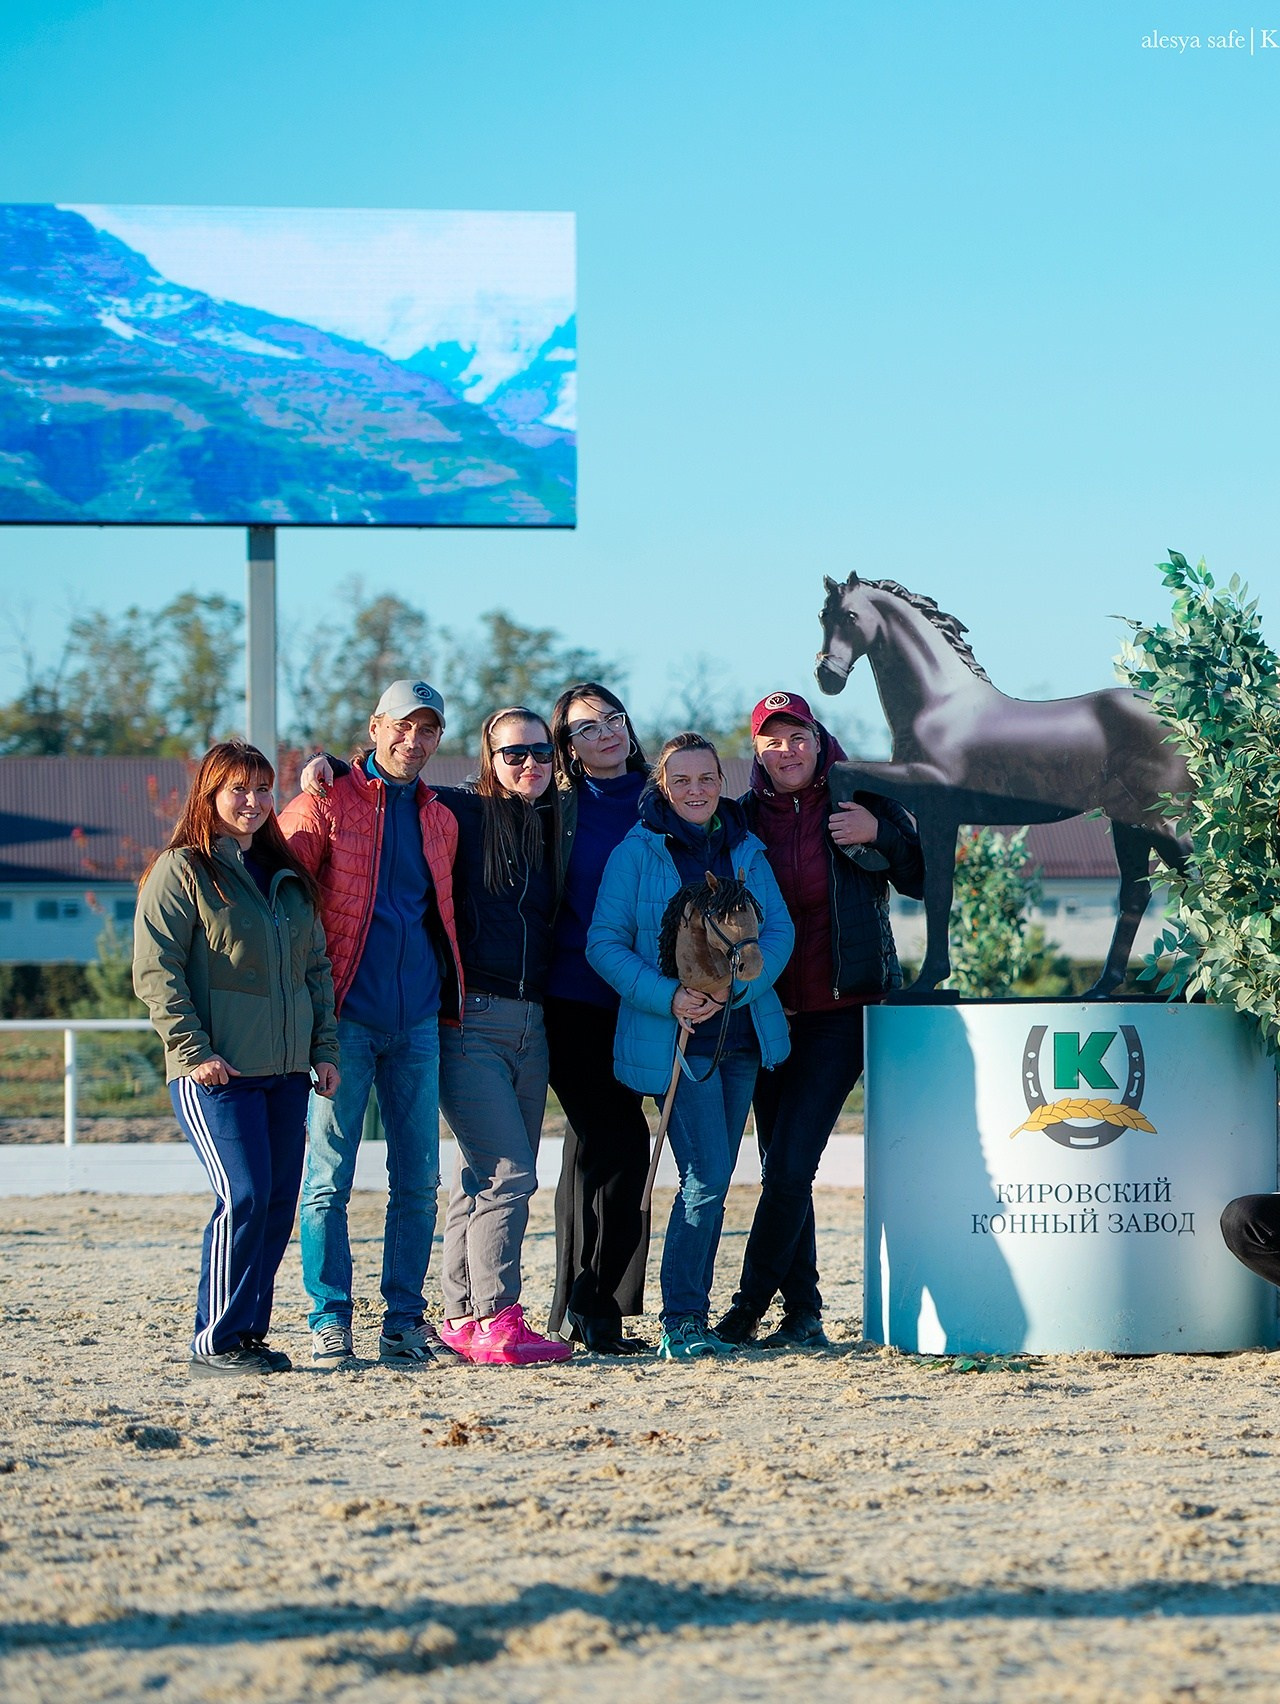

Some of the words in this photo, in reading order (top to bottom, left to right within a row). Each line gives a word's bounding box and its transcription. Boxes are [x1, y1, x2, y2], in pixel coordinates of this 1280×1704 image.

[1053, 1031, 1119, 1090] К
[995, 1176, 1172, 1204] КИРОВСКИЙ
[971, 1208, 1099, 1234] КОННЫЙ
[1107, 1212, 1195, 1236] ЗАВОД
